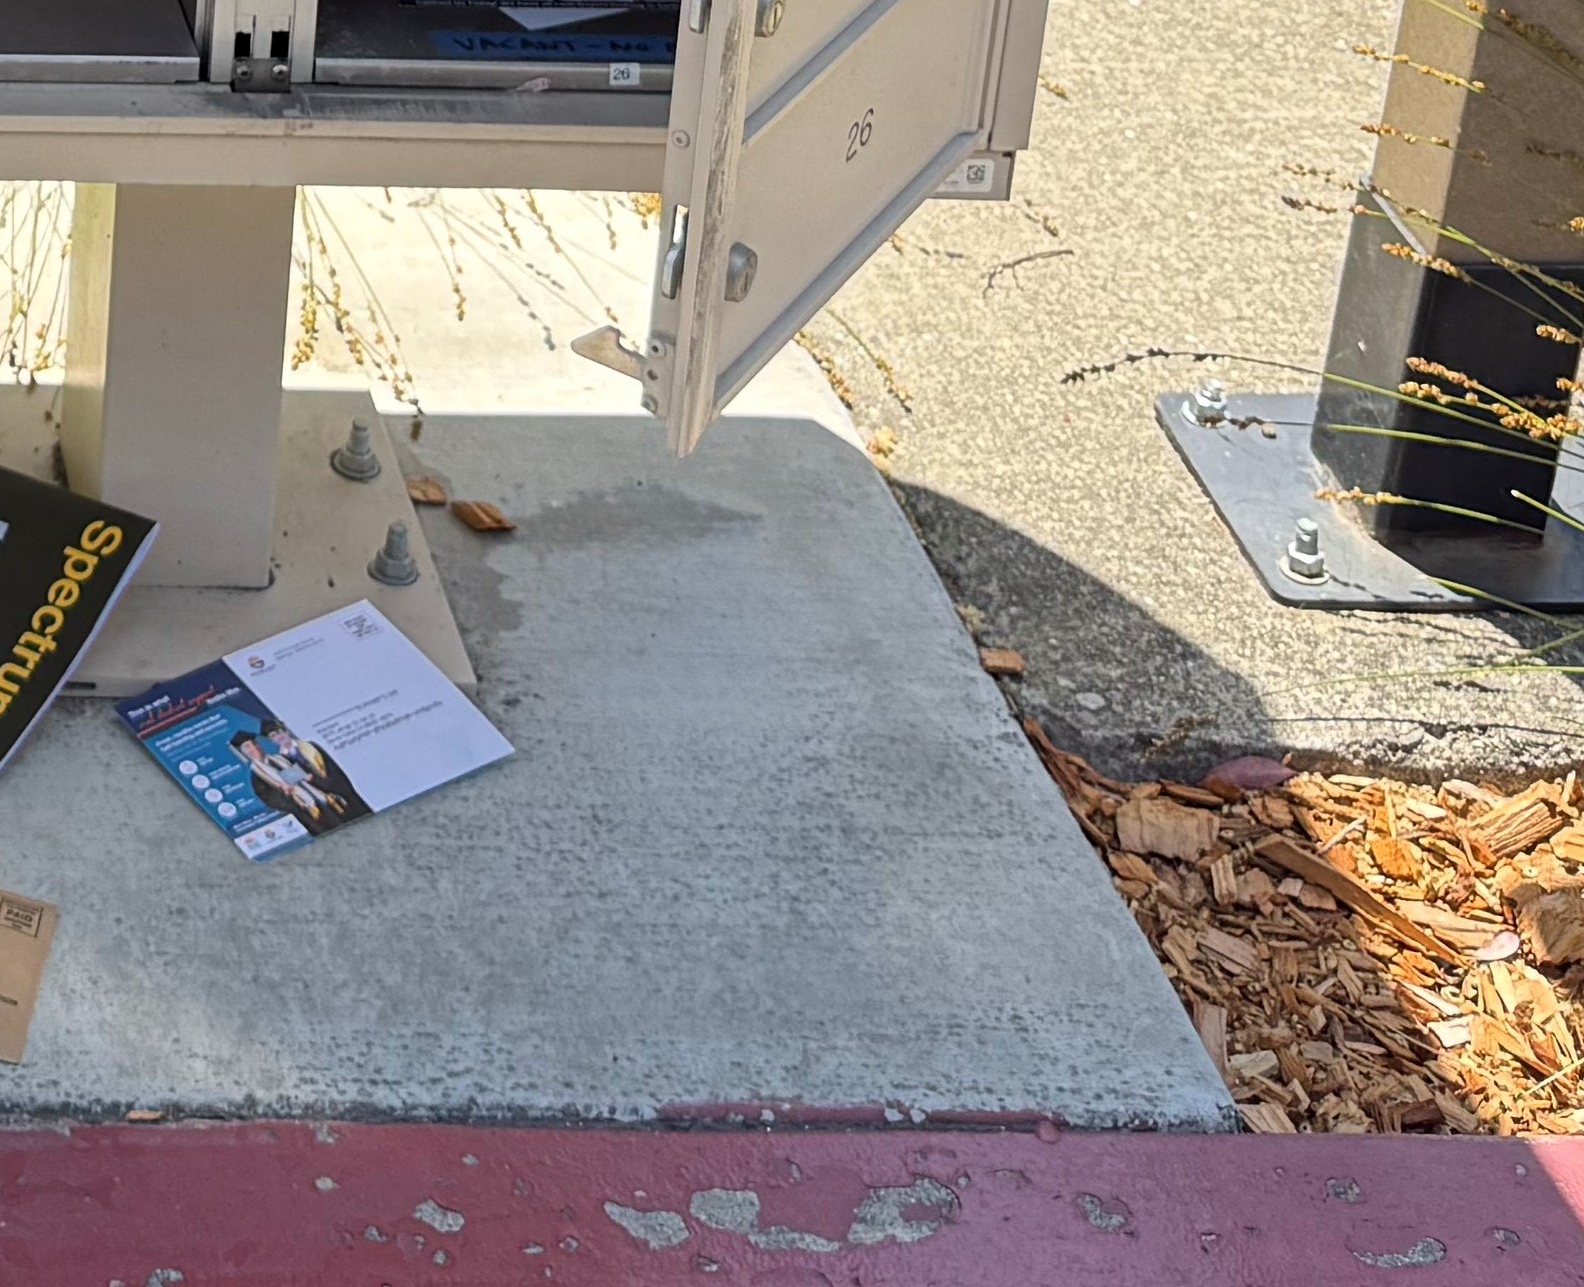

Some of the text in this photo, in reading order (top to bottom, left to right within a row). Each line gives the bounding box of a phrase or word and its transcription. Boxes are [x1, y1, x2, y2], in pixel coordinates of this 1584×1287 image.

[452, 36, 577, 53] VACANT
[612, 67, 631, 81] 26
[845, 107, 875, 163] 26
[5, 908, 34, 923] PAID
